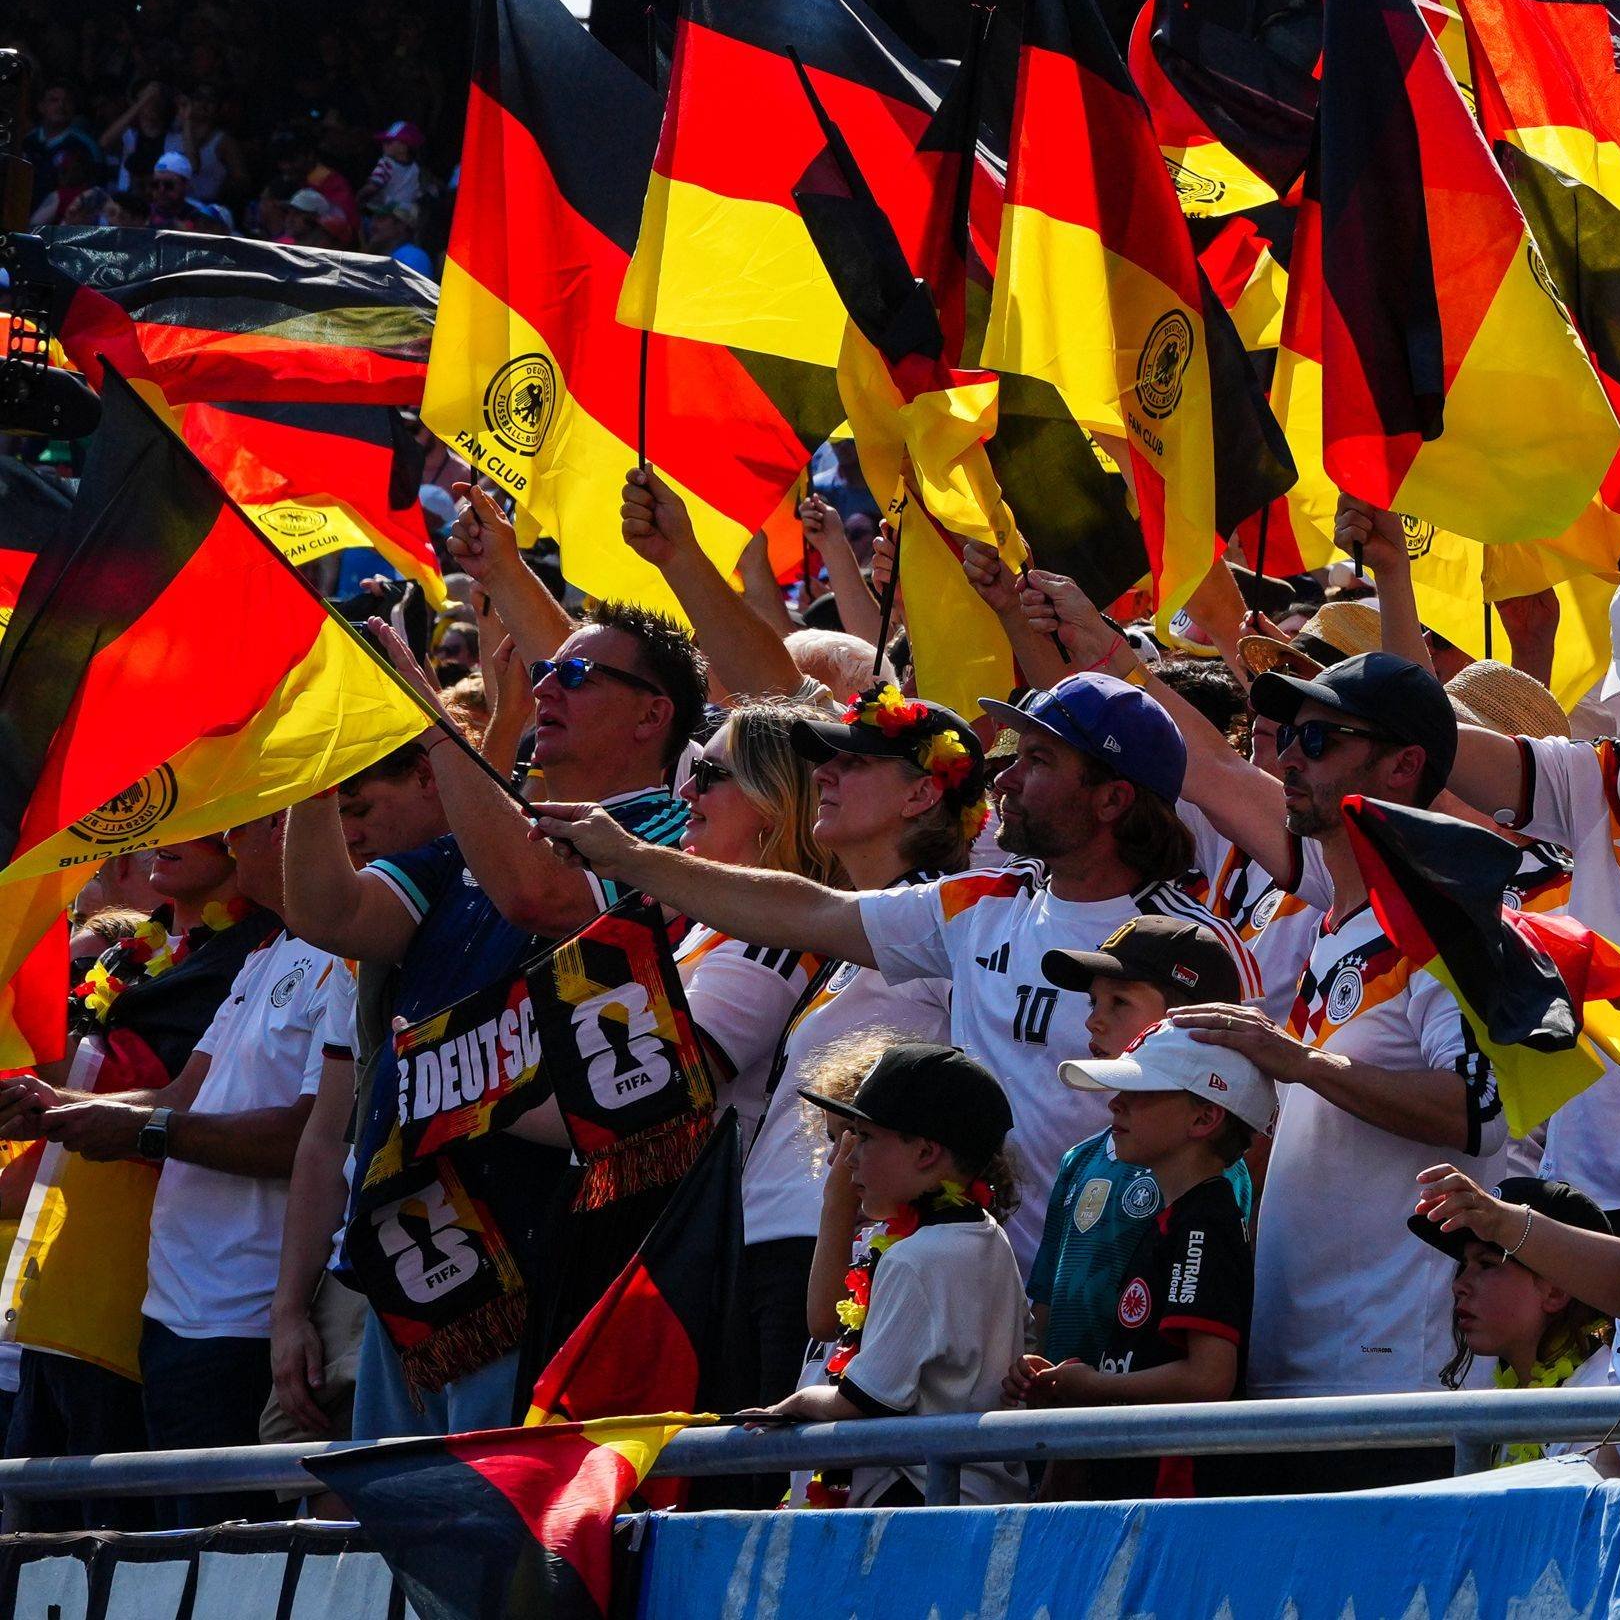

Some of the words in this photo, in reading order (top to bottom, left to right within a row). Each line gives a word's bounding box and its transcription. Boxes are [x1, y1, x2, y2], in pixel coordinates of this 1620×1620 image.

[497, 394, 541, 444] FUSSBALL-BU
[1128, 411, 1143, 438] FAN
[1142, 428, 1165, 457] CLUB
[455, 430, 487, 461] FAN
[486, 456, 527, 492] CLUB
[309, 535, 340, 549] CLUB
[1012, 984, 1061, 1047] 10
[614, 1071, 653, 1096] FIFA
[424, 1262, 462, 1289] FIFA
[1167, 1261, 1182, 1304] reload
[1179, 1229, 1205, 1305] ELOTRANS
